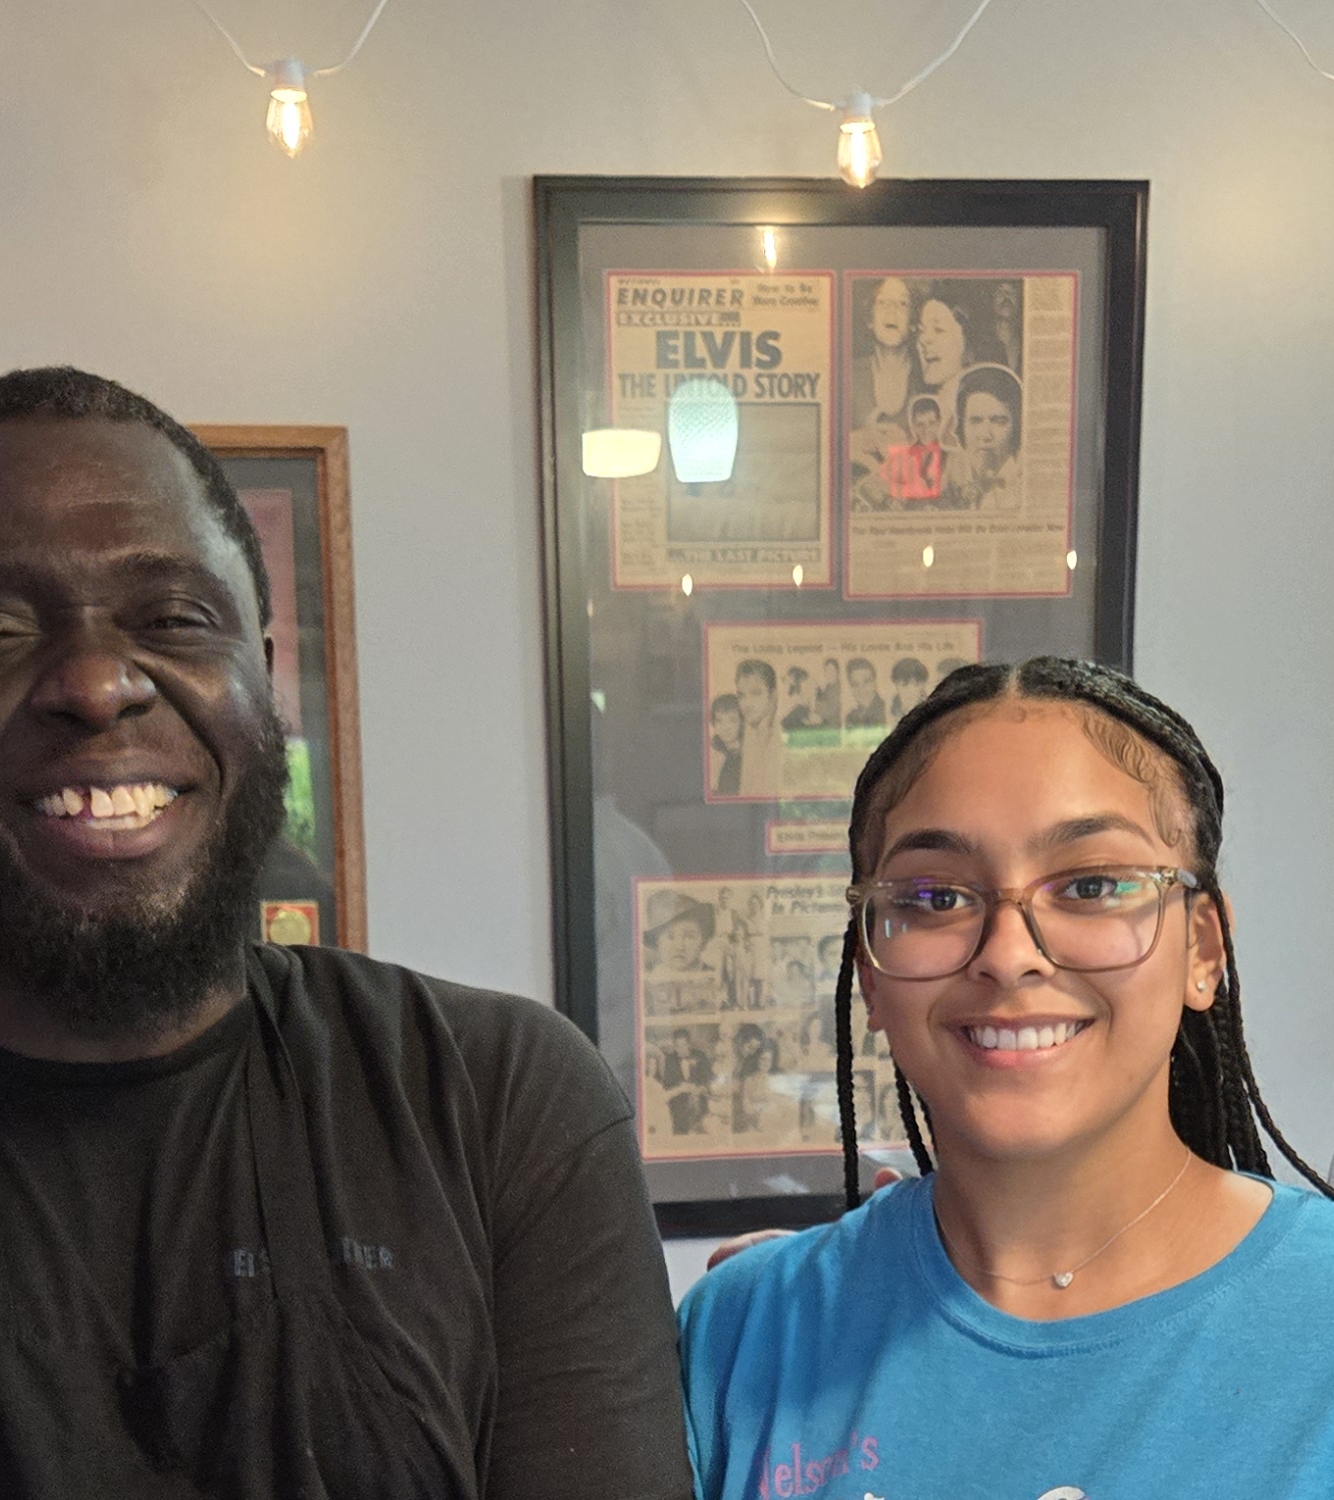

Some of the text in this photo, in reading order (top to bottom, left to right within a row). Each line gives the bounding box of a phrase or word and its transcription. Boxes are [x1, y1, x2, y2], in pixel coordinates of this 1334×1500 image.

[617, 287, 745, 308] ENQUIRER
[655, 330, 783, 370] ELVIS
[618, 373, 657, 398] THE
[754, 373, 821, 398] STORY
